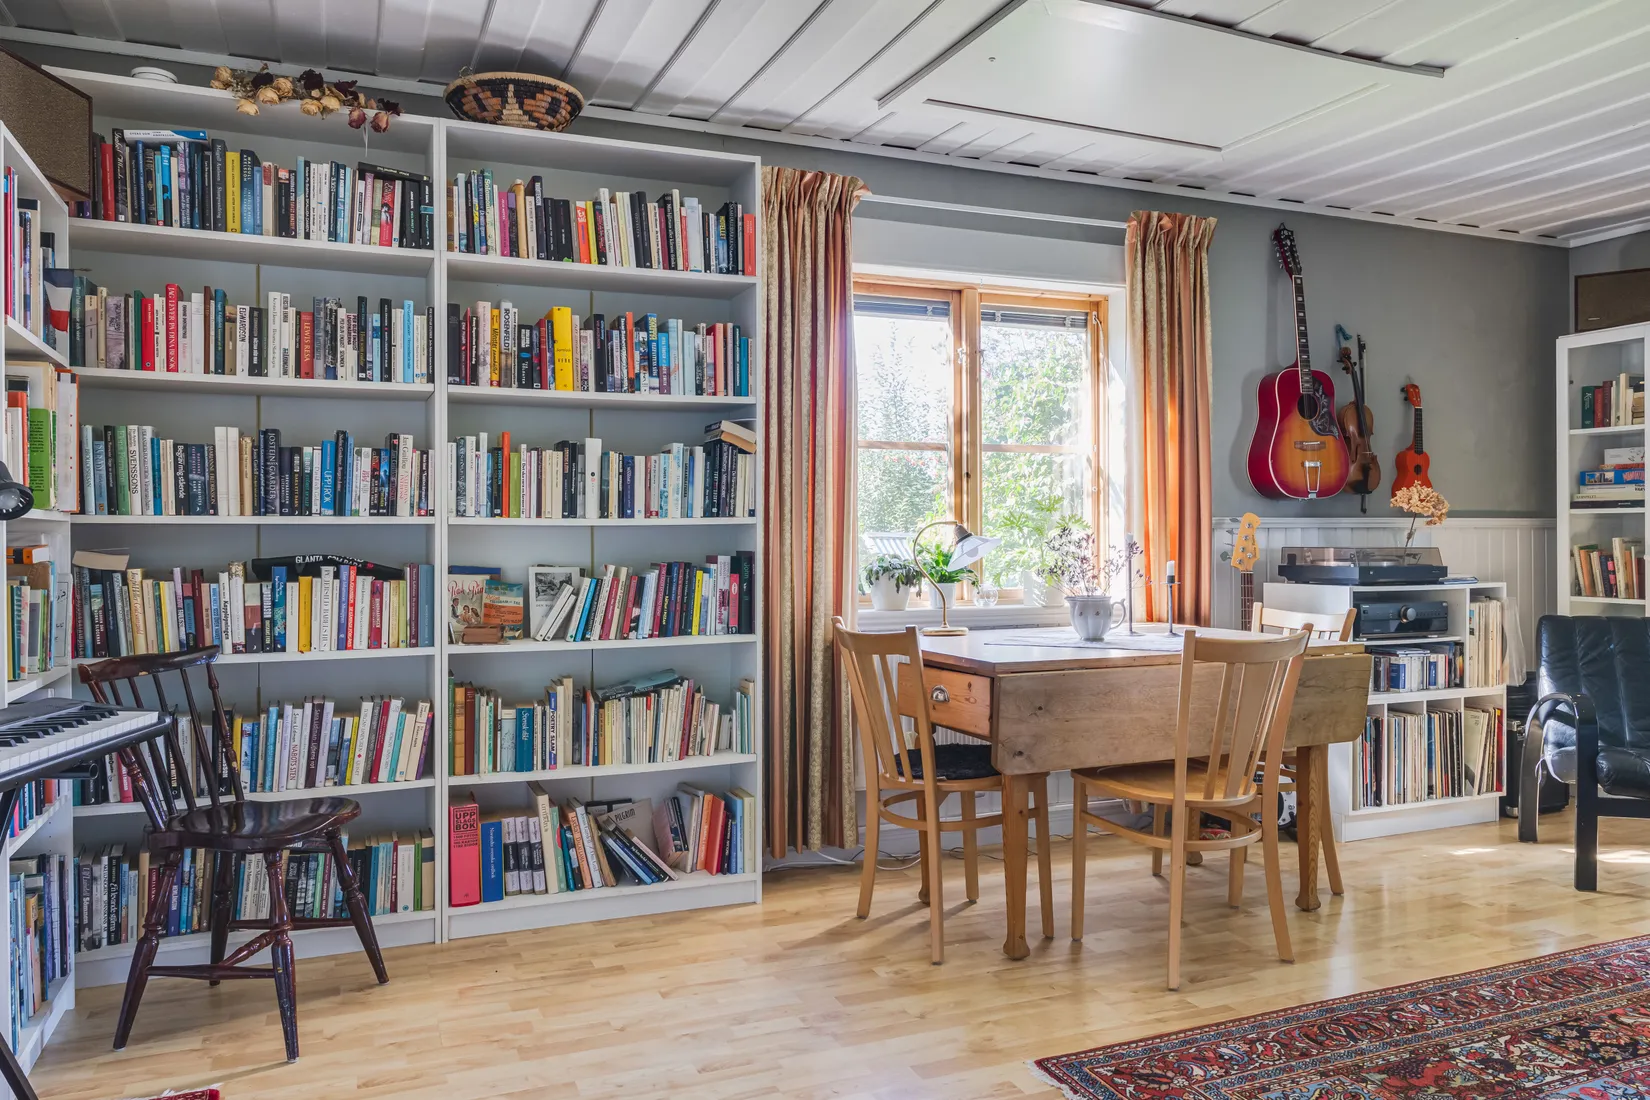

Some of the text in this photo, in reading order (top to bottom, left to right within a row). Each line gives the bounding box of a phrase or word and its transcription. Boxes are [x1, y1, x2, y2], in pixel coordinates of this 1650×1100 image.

[176, 446, 184, 465] Begrav
[130, 450, 138, 494] SVENSSONS
[324, 488, 332, 502] RÖK
[521, 711, 529, 729] Svensk
[455, 811, 476, 820] UPP
[615, 809, 636, 822] PILGRIM
